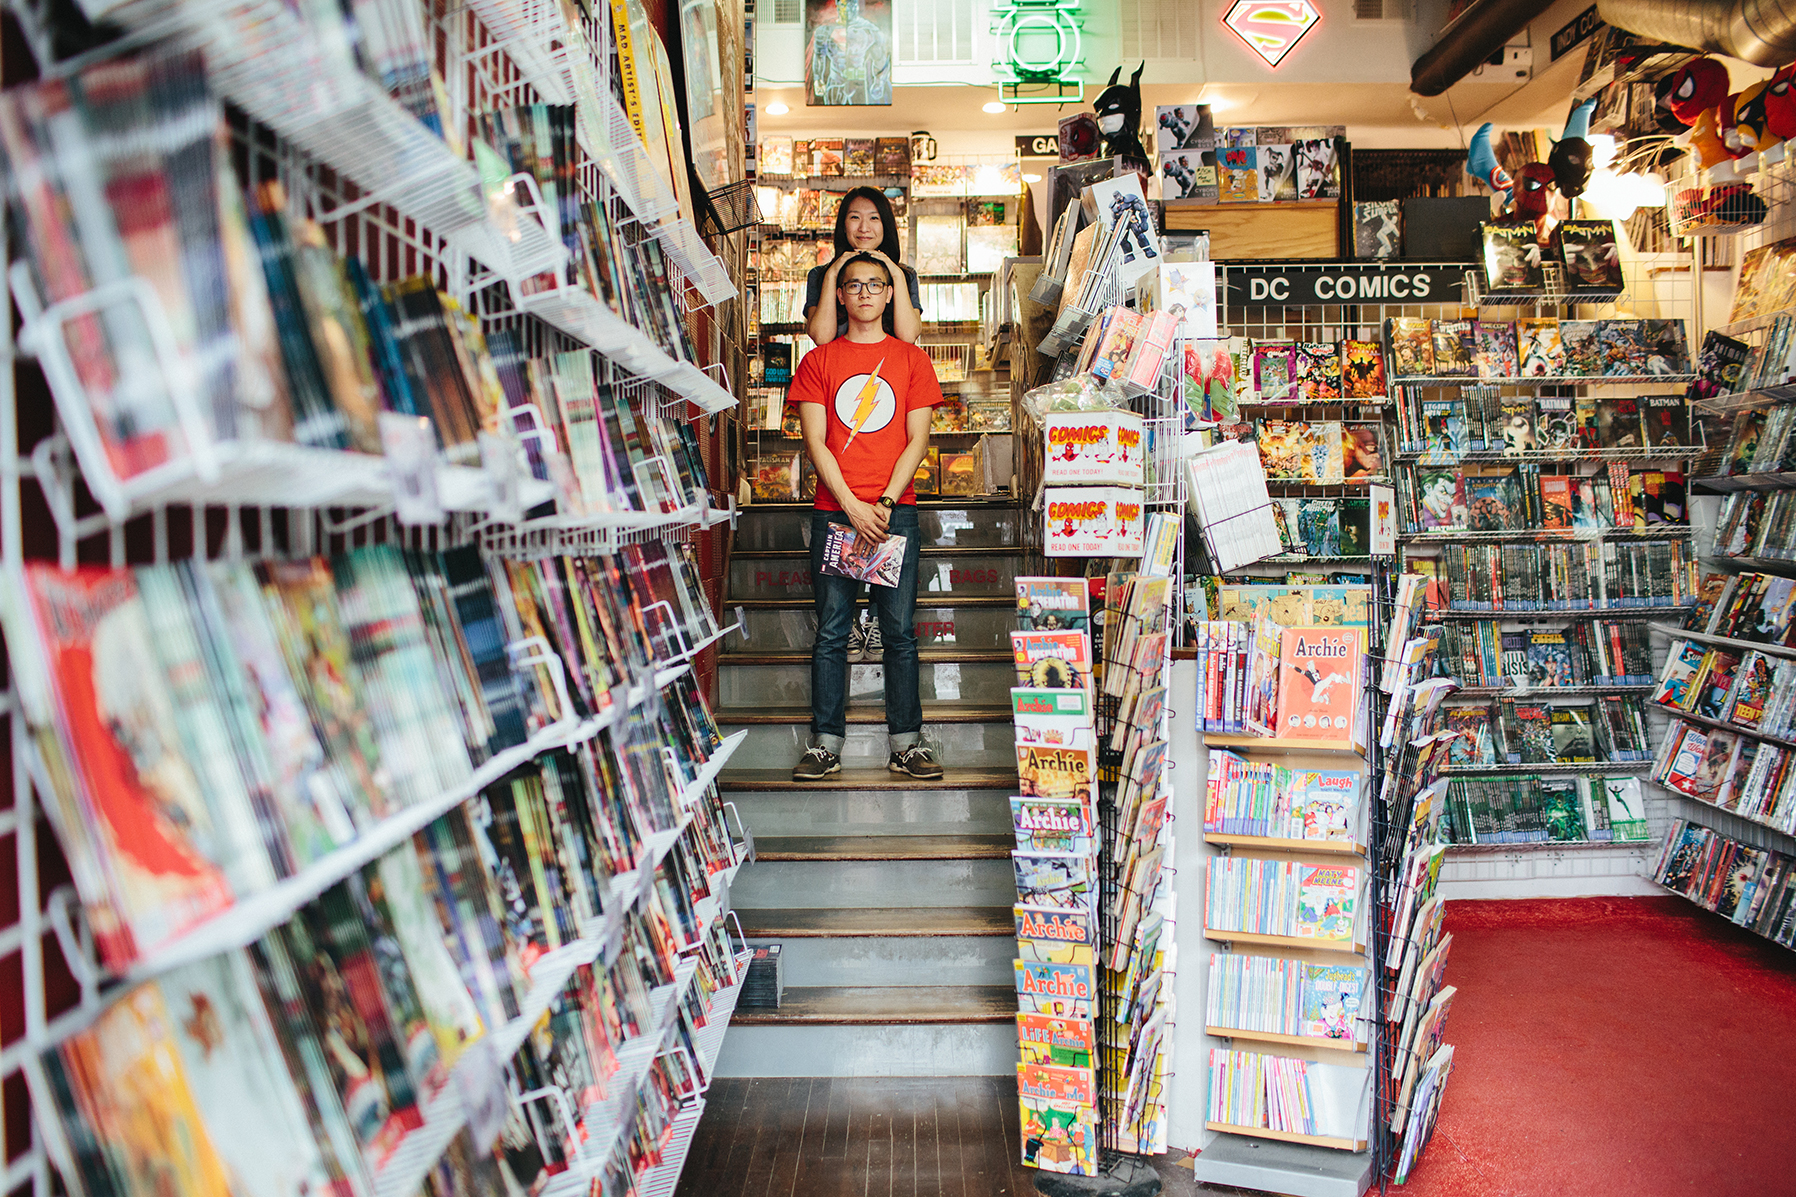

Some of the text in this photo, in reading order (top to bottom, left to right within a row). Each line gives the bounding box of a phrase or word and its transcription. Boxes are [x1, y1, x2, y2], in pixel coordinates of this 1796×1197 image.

[618, 24, 629, 50] MAD
[622, 55, 637, 107] ARTIST'S
[1484, 225, 1533, 242] BATMAN
[1563, 224, 1613, 240] BATMAN
[1250, 273, 1431, 301] DC COMICS
[1650, 398, 1680, 407] BATMAN
[1048, 425, 1109, 443] COMICS
[1048, 501, 1108, 519] COMICS
[823, 534, 834, 561] CAPTAIN
[829, 530, 845, 568] AMERICA
[1051, 543, 1066, 551] READ
[1082, 543, 1103, 551] TODAY!
[949, 569, 998, 584] BAGS
[1030, 583, 1062, 597] Archie
[1026, 637, 1058, 650] Archie
[1294, 636, 1347, 657] Archie
[1017, 697, 1053, 713] Archie
[1028, 747, 1085, 774] Archie
[1317, 774, 1353, 790] Laugh
[1019, 805, 1081, 832] Archie
[1312, 876, 1344, 886] KEENE
[1317, 868, 1344, 878] KATY
[1021, 912, 1087, 941] Archie
[1022, 969, 1088, 997] Archie
[1325, 968, 1355, 982] Jughead's
[1052, 1031, 1085, 1049] Archie
[1022, 1079, 1056, 1098] Archie
[1066, 1087, 1084, 1101] Me
